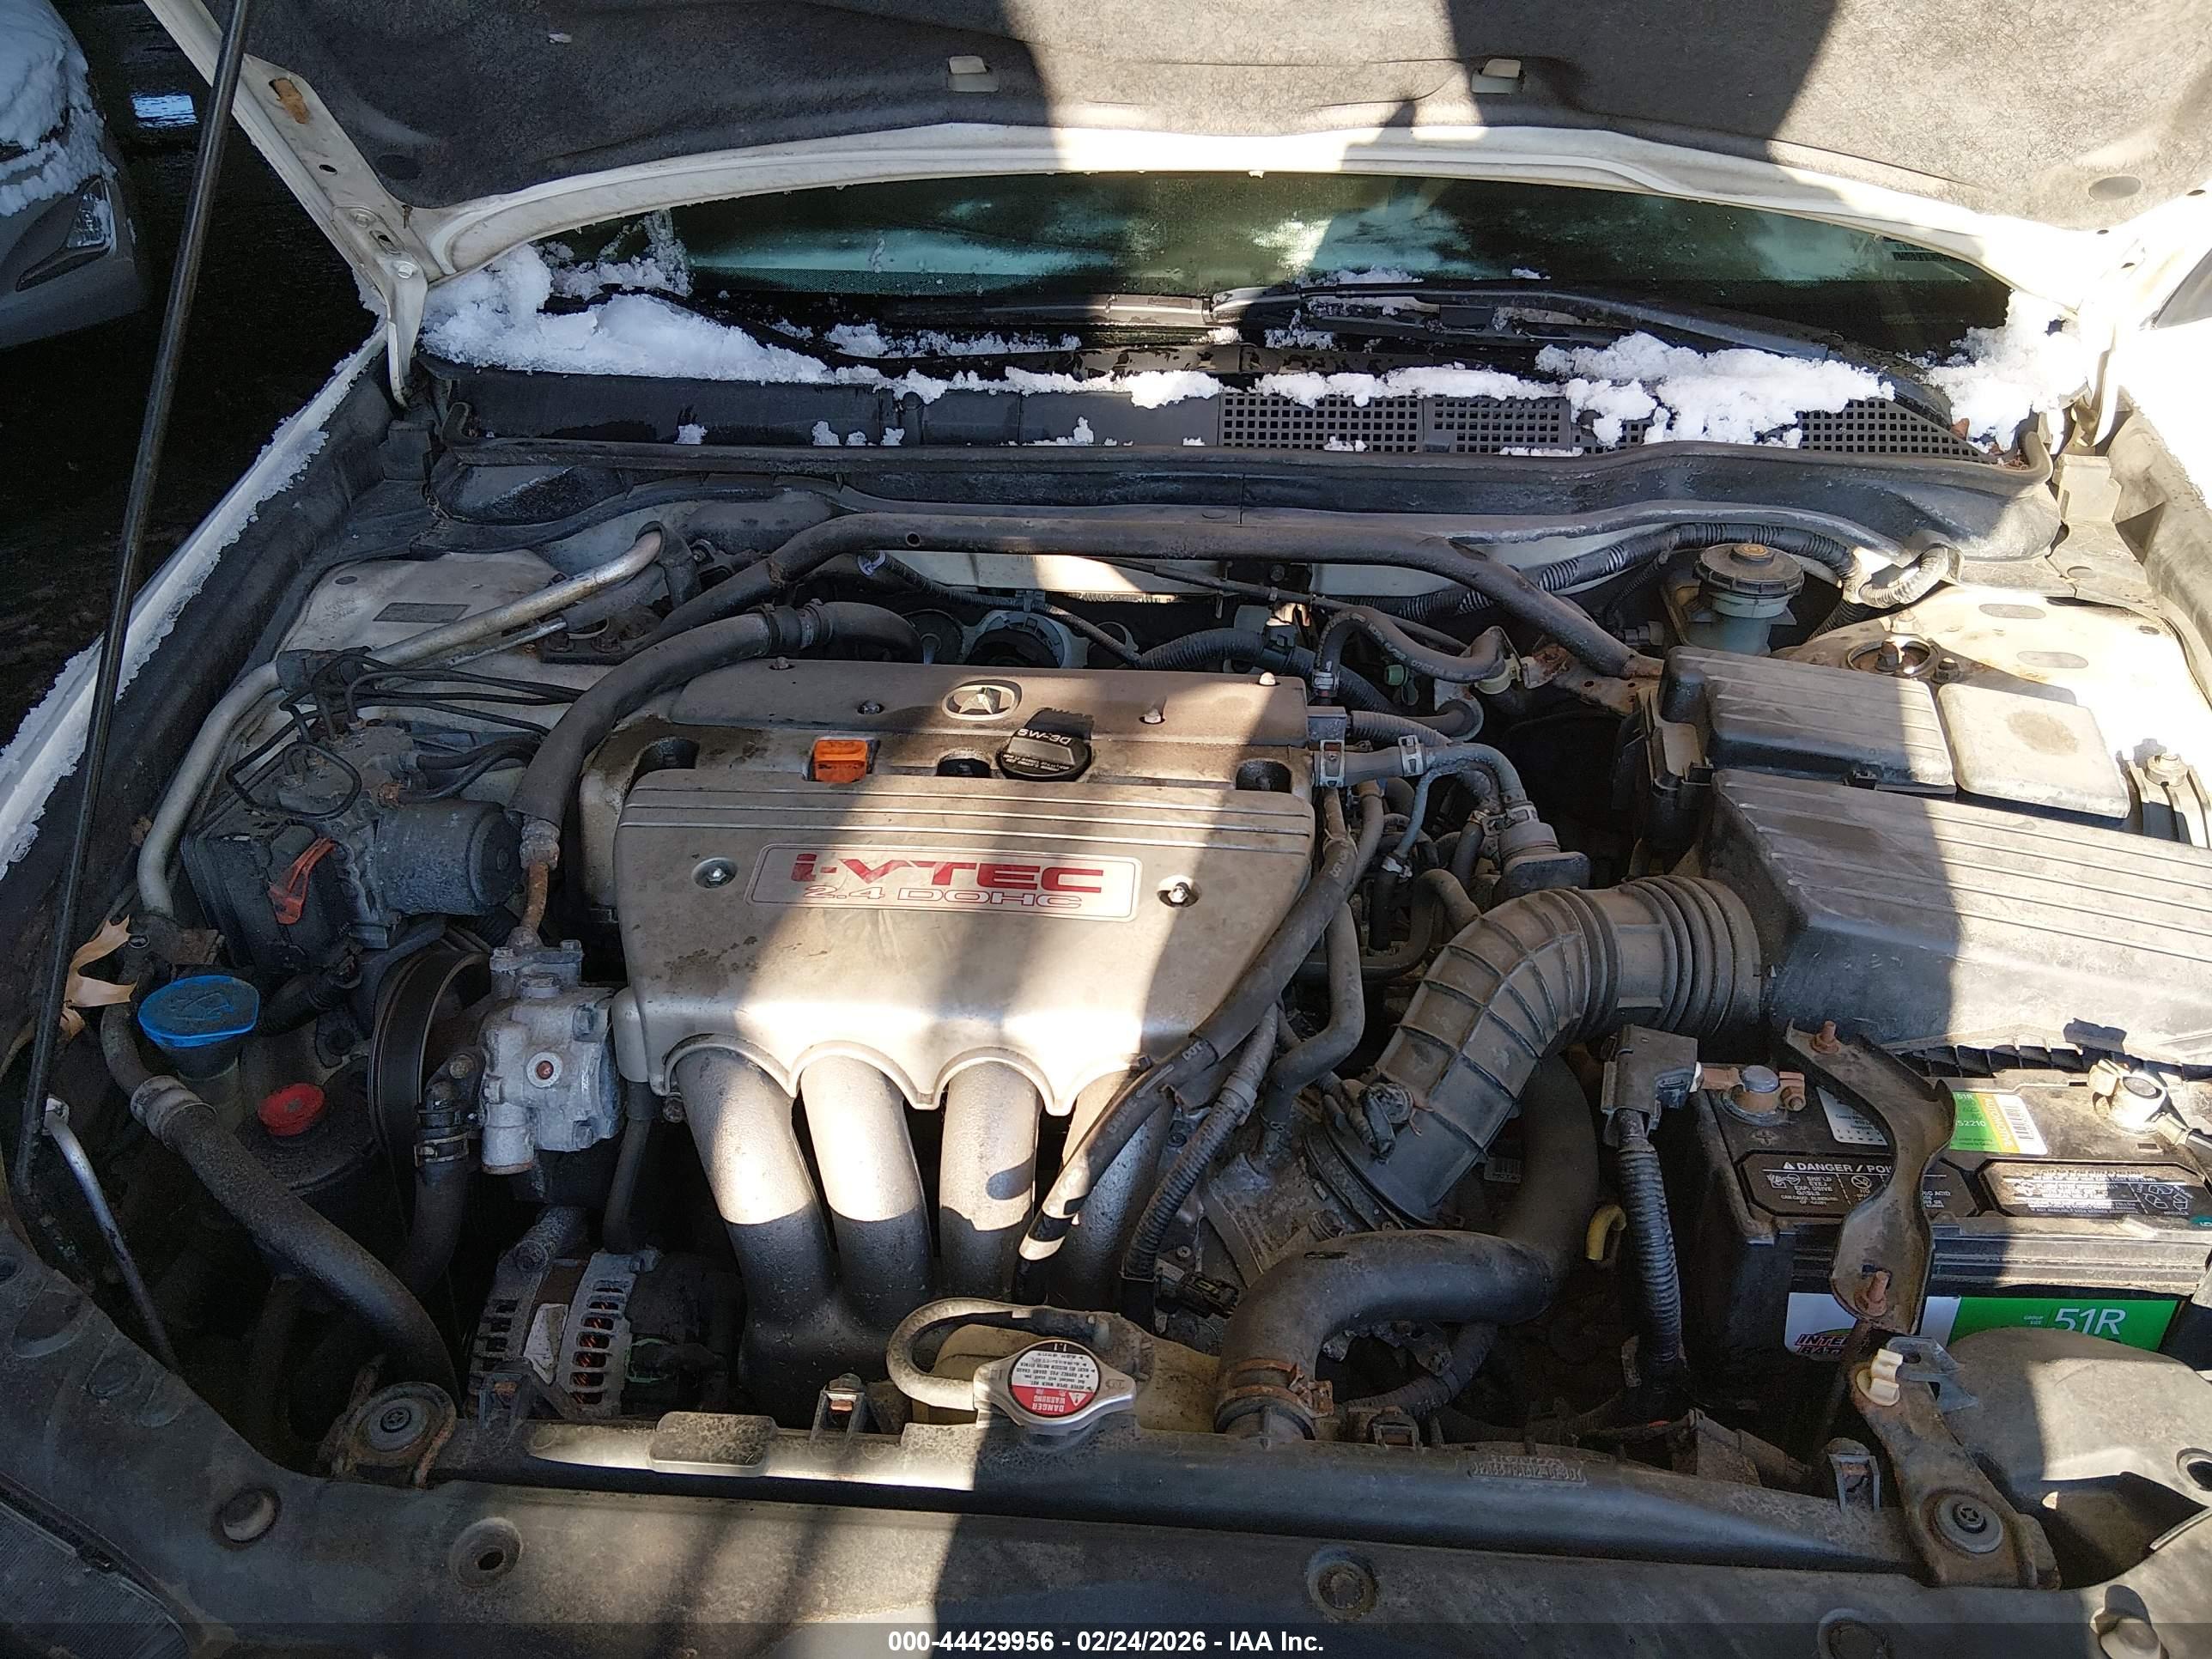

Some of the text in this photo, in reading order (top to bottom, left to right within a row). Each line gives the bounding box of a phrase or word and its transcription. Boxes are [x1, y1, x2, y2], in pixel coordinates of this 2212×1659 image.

[1017, 728, 1072, 745] 5W-30
[791, 854, 1103, 893] i-VTEC
[803, 885, 1082, 908] 2.4 DOHC
[1796, 1162, 1852, 1172] DANGER
[2055, 1307, 2126, 1335] 51R
[1054, 1343, 1067, 1352] 1.1
[1032, 1403, 1065, 1412] DANGER
